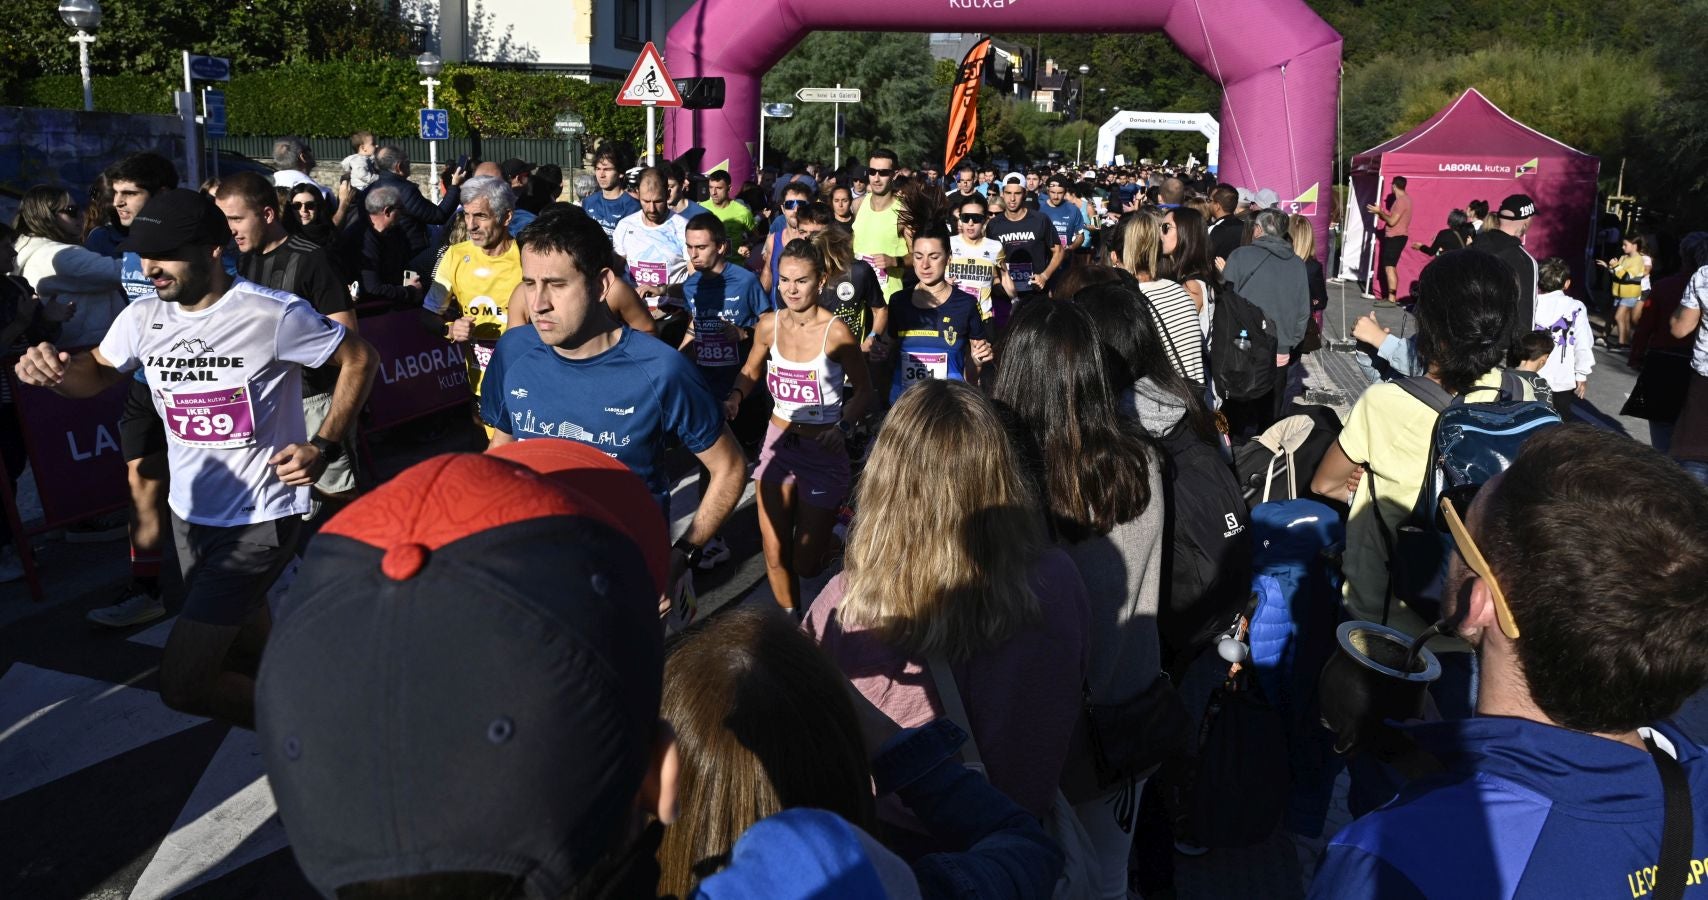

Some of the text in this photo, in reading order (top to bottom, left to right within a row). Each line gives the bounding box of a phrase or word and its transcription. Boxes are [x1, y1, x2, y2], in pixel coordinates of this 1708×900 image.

[1438, 163, 1511, 173] LABORAL kutxa
[998, 231, 1035, 243] YWNWA
[635, 270, 660, 283] 596
[948, 263, 993, 277] BEHOBIA
[696, 346, 734, 360] 2882
[380, 344, 467, 384] LABORAL
[160, 370, 218, 382] TRAIL
[439, 370, 466, 390] kutx
[771, 380, 815, 400] 1076
[172, 413, 234, 436] 739
[66, 418, 123, 461] LA
